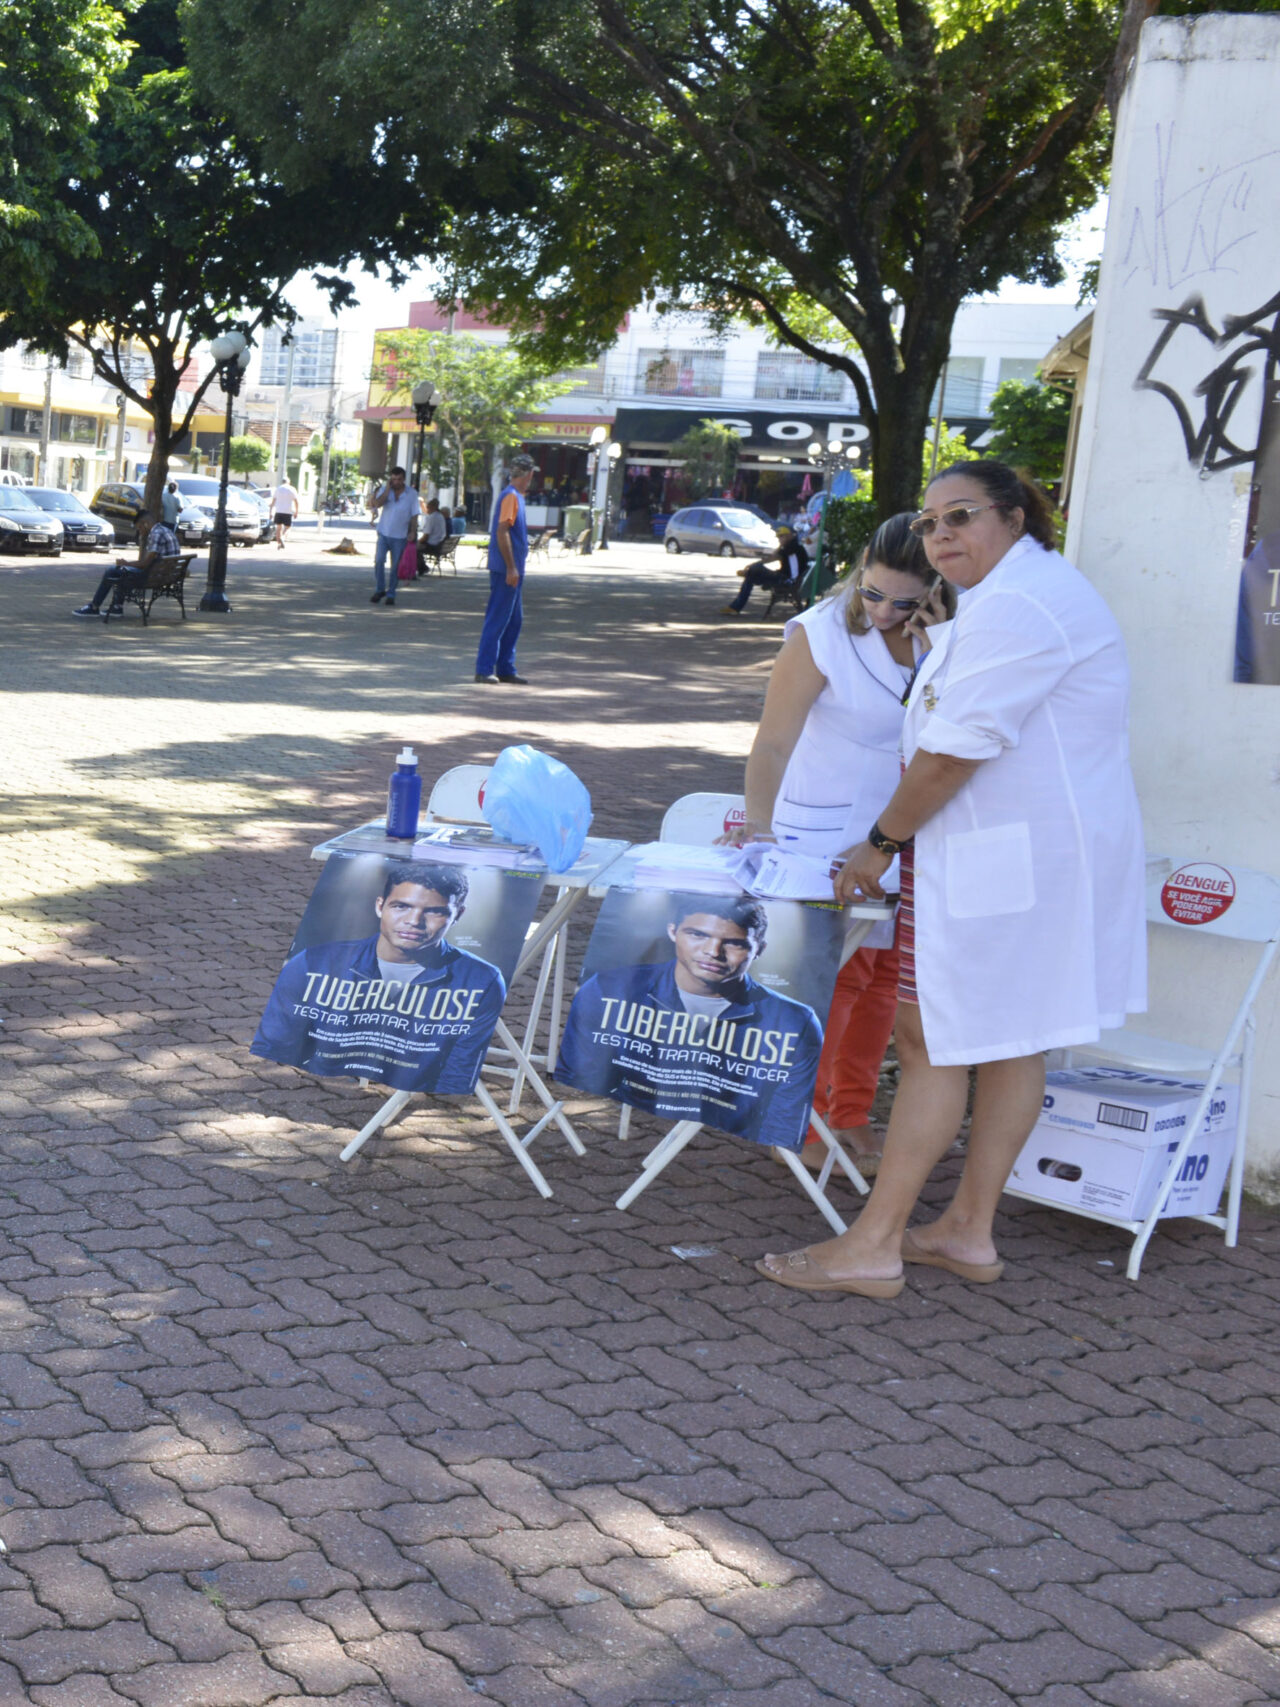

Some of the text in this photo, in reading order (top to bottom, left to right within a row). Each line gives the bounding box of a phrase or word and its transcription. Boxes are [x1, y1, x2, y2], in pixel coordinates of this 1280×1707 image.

[715, 418, 870, 442] GOD
[1174, 874, 1230, 893] DENGUE
[1167, 890, 1178, 898] SE
[1179, 892, 1202, 903] VOCÊ
[1172, 900, 1213, 914] PODEMOS
[302, 972, 484, 1020] TUBERCULOSE
[414, 1022, 471, 1036] VENCER.
[600, 998, 798, 1066] TUBERCULOSE
[726, 1060, 791, 1084] VENCER.
